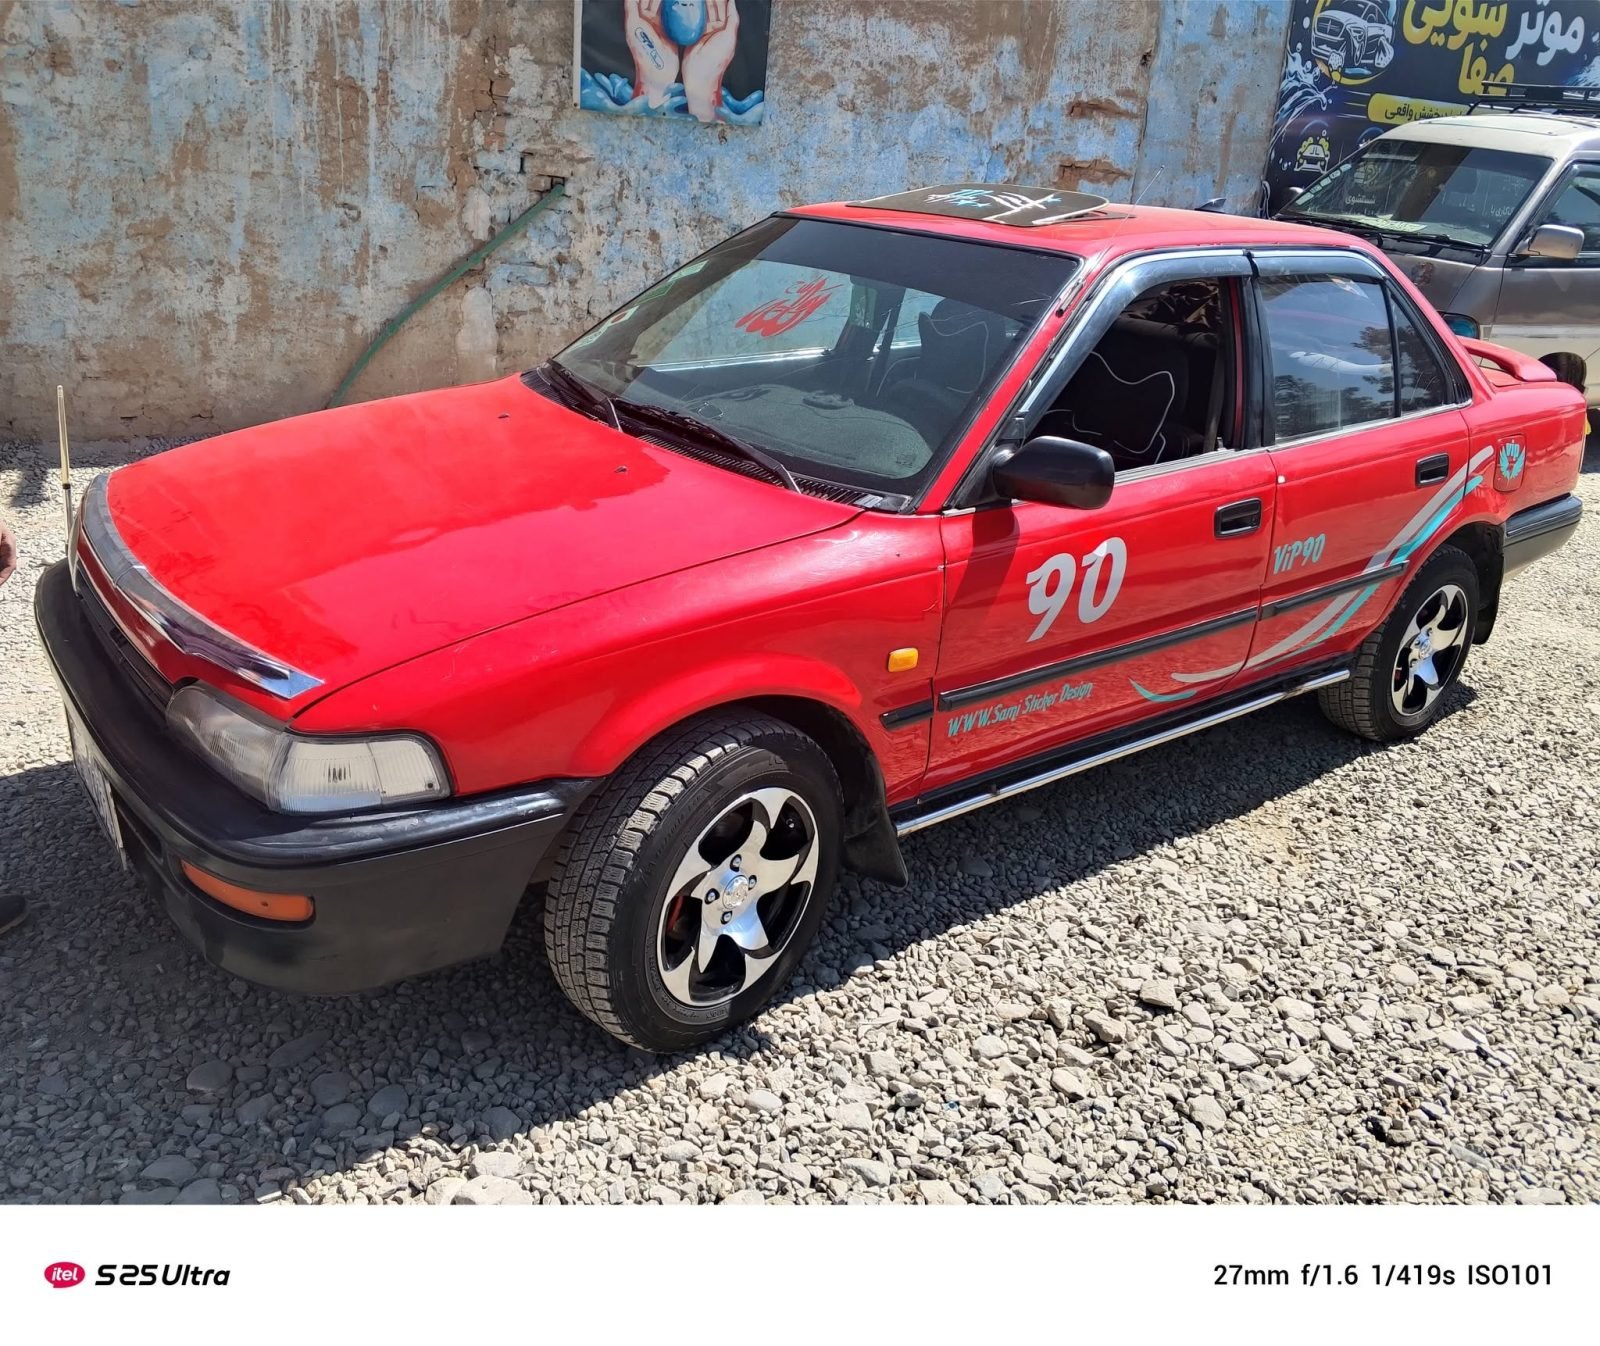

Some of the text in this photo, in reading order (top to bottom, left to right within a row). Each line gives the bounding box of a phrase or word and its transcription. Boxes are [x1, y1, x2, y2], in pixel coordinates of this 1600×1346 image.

[1505, 0, 1585, 66] موتر
[1458, 38, 1515, 95] صفا
[1025, 536, 1128, 643] 90
[1059, 681, 1094, 703] Design
